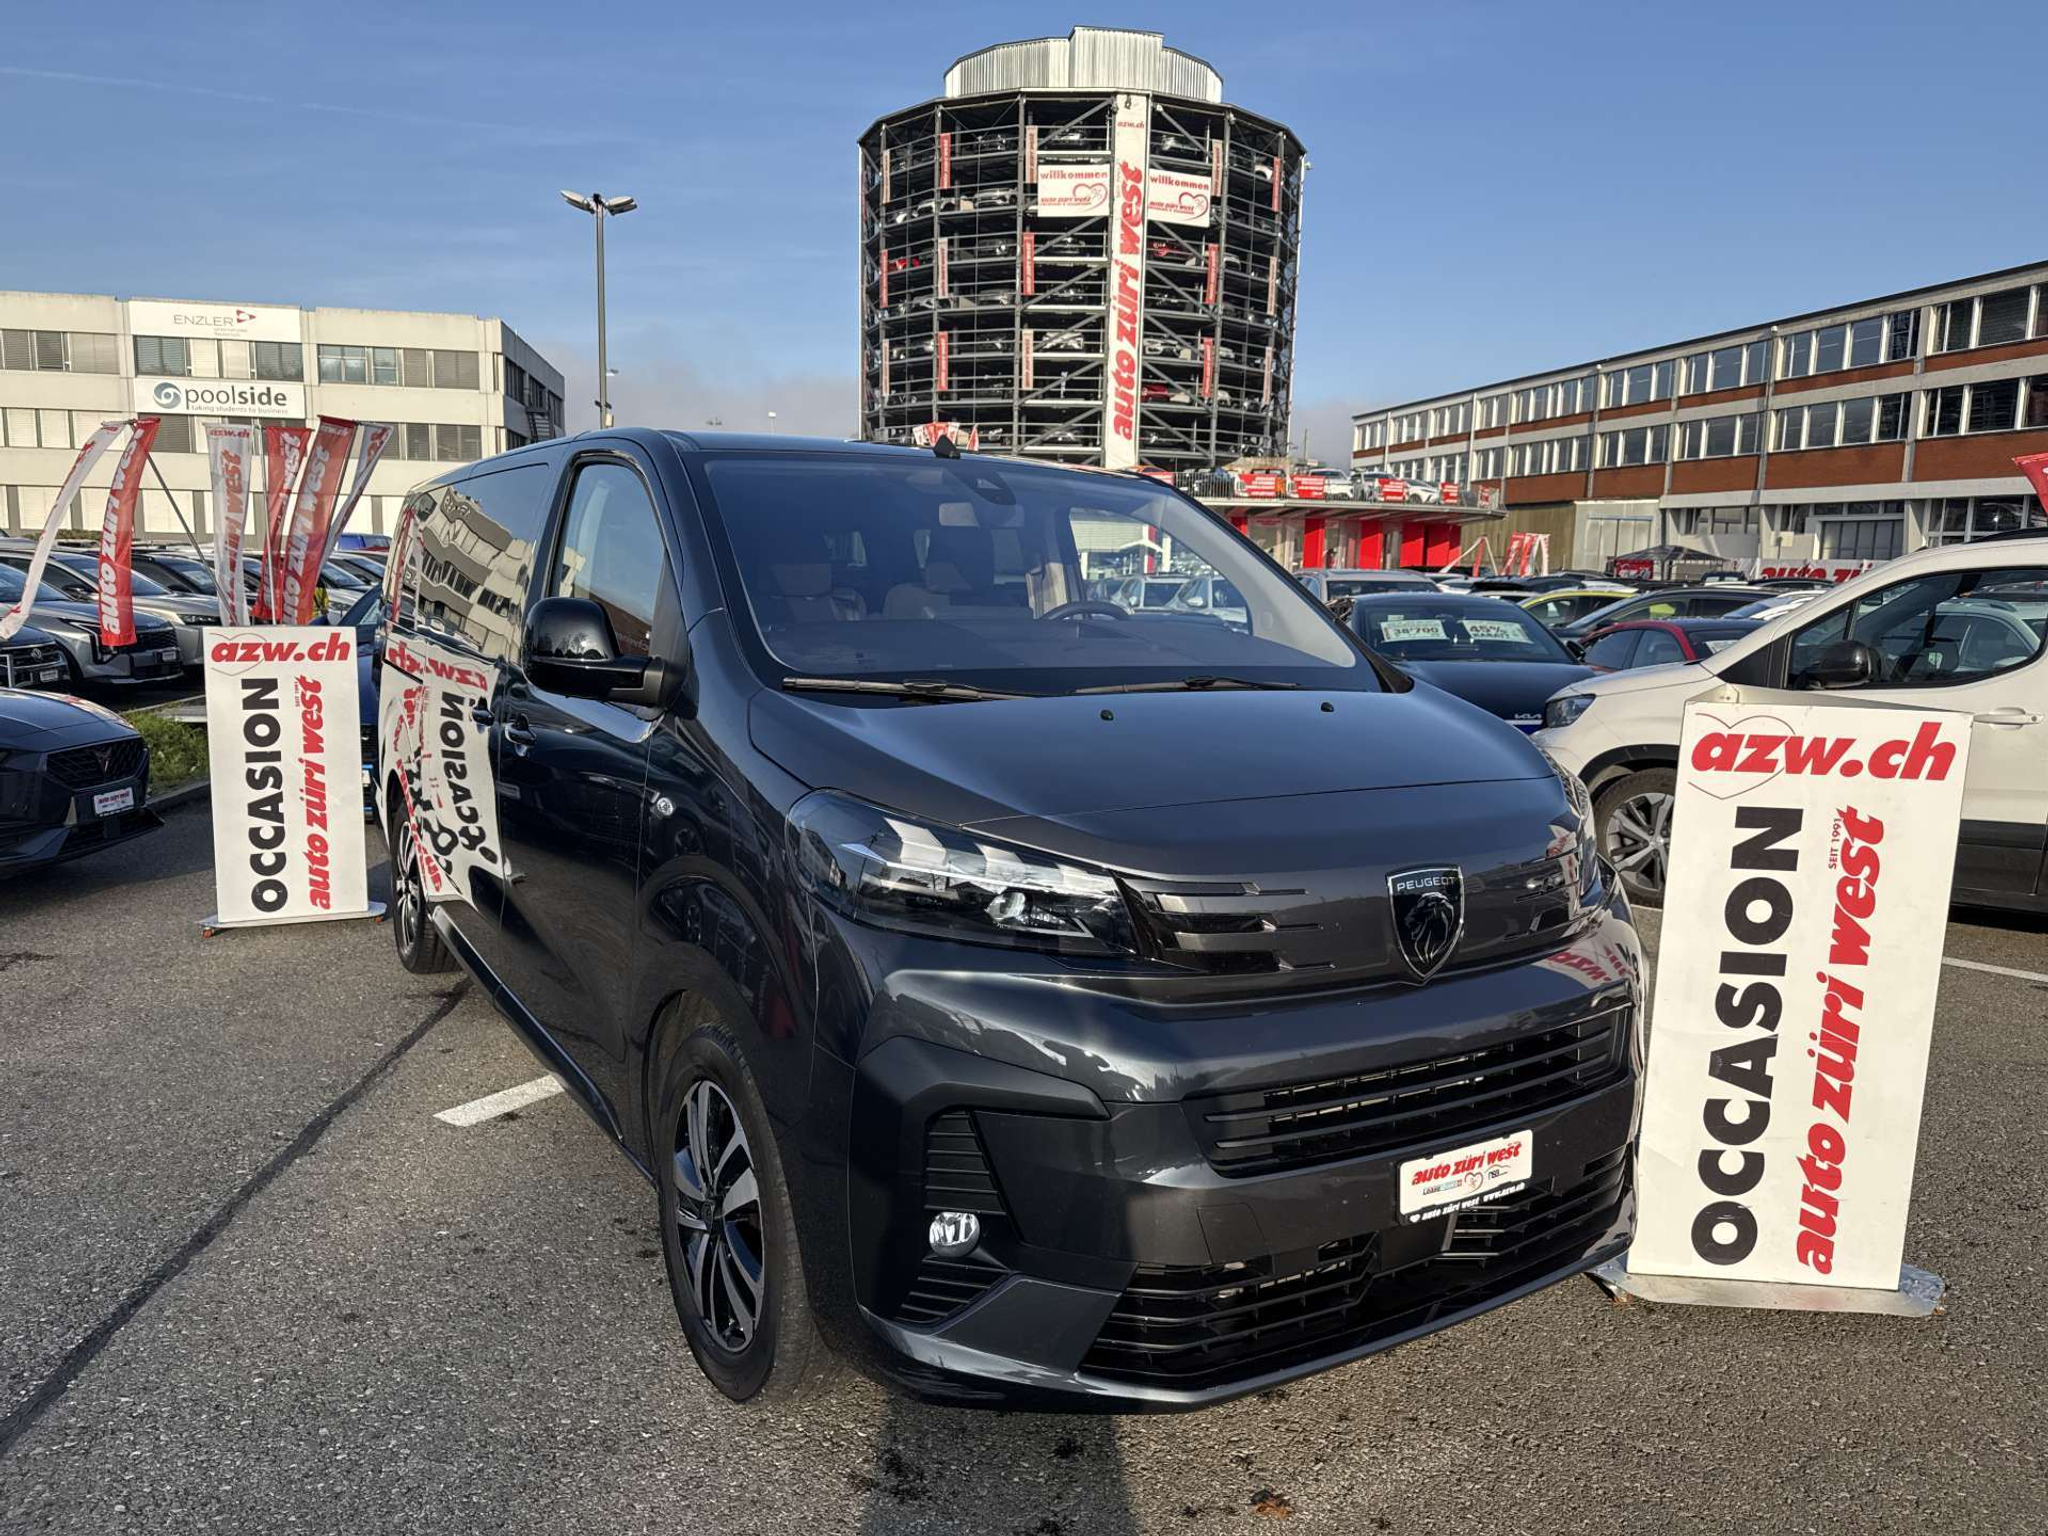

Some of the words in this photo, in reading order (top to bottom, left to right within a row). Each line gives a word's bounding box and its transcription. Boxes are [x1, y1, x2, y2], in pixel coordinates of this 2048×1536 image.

[1040, 169, 1108, 180] willkommen
[1150, 174, 1209, 190] willkommen
[1118, 161, 1143, 255] west
[173, 314, 234, 326] ENZLER
[1112, 259, 1139, 348] züri
[185, 384, 288, 410] poolside
[216, 405, 247, 413] students
[257, 406, 288, 414] business
[1111, 349, 1136, 441] auto
[221, 448, 245, 514] west
[101, 562, 120, 635] auto
[211, 632, 351, 662] azw.ch
[296, 674, 324, 754] west
[1691, 721, 1957, 781] azw.ch
[241, 678, 288, 913] OCCASION
[298, 757, 328, 832] züri
[1829, 843, 1838, 870] SEIT
[1830, 817, 1841, 842] 1991
[302, 833, 331, 910] auto
[1396, 875, 1456, 892] PEUGEOT
[1828, 805, 1885, 968] west
[1691, 805, 1804, 1266] OCCASION
[1807, 971, 1865, 1126] züri
[1412, 1164, 1451, 1186] auto
[1451, 1151, 1486, 1176] züri
[1487, 1143, 1522, 1165] west
[1461, 1197, 1480, 1209] west
[1796, 1121, 1846, 1275] auto
